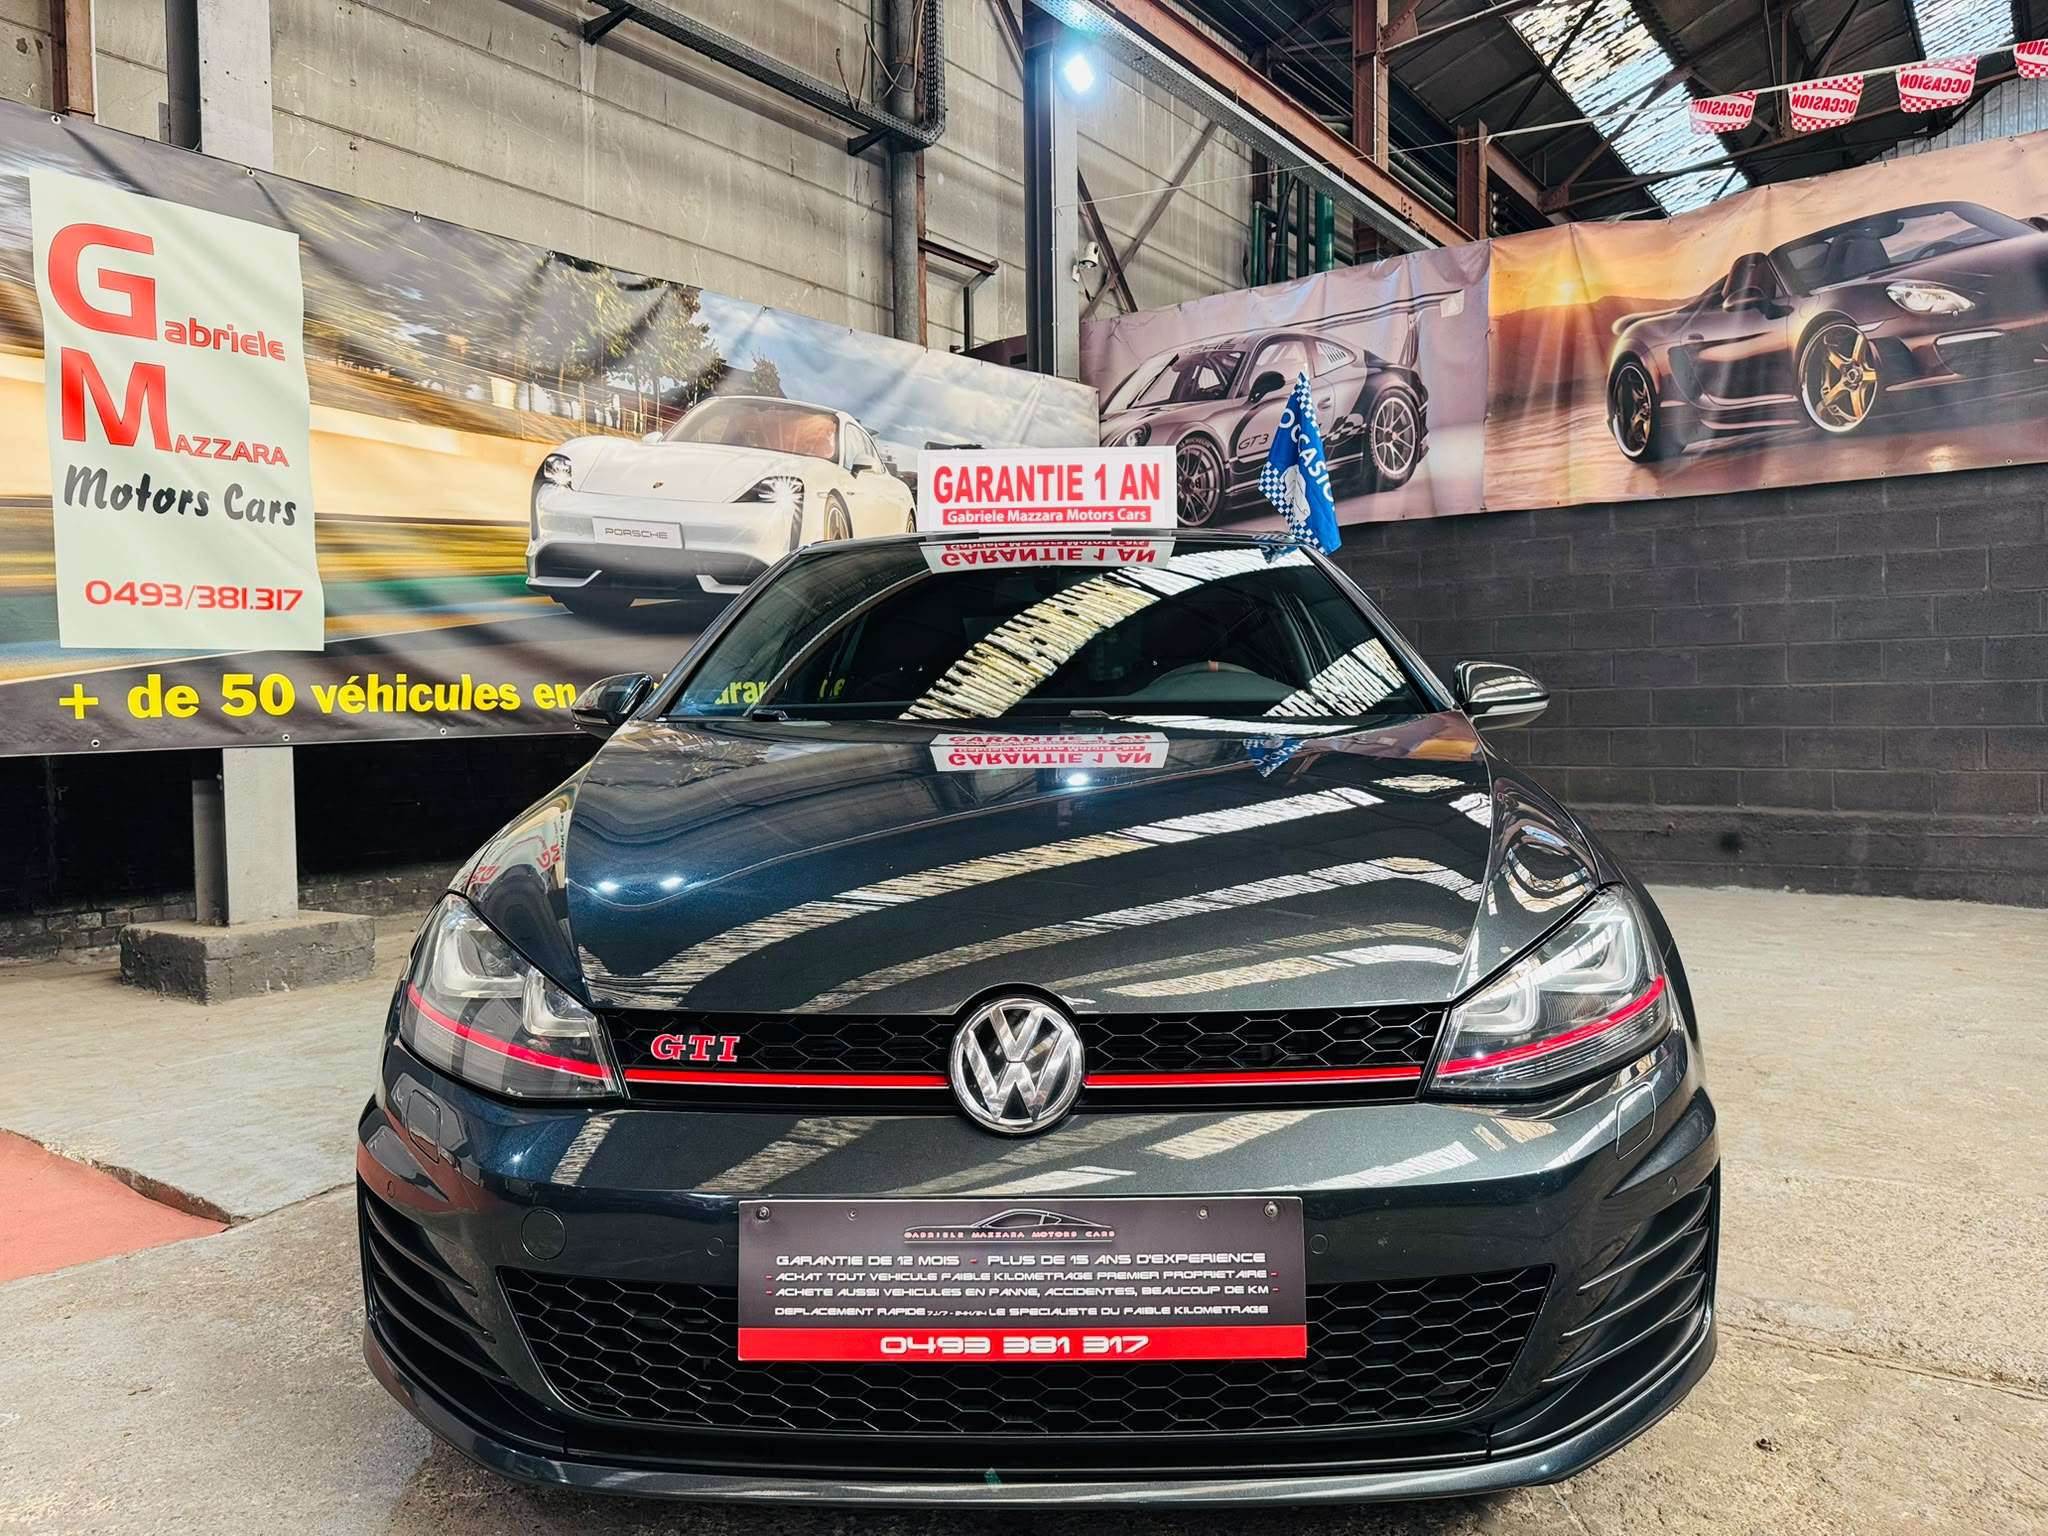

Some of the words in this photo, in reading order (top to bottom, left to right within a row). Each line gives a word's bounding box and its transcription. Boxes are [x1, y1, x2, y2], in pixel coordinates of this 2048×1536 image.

[1238, 433, 1270, 450] GT3
[933, 464, 1084, 504] GARANTIE
[1094, 464, 1106, 501] 1
[1120, 464, 1160, 500] AN
[65, 466, 208, 516] Motors
[225, 484, 296, 525] Cars
[948, 510, 1004, 522] Gabriele
[1008, 510, 1063, 521] Mazzara
[1067, 509, 1114, 520] Motors
[1118, 508, 1146, 520] Cars
[605, 528, 669, 539] PORSCHE
[85, 580, 304, 612] 0493/381.317
[128, 674, 199, 718] de
[222, 673, 295, 716] 50
[312, 674, 521, 714] véhicules
[534, 684, 576, 709] en
[651, 1030, 740, 1063] GTI
[775, 1255, 864, 1266] GARANTIE
[867, 1255, 893, 1266] DE
[896, 1255, 914, 1266] 12
[917, 1255, 960, 1266] MOIS
[986, 1254, 1036, 1266] PLUS
[1040, 1254, 1066, 1266] DE
[1069, 1254, 1090, 1265] 15
[1093, 1254, 1132, 1265] ANS
[1136, 1252, 1266, 1265] D'EXPERIENCE
[775, 1272, 824, 1282] ACHAT
[826, 1272, 867, 1282] TOUT
[868, 1272, 938, 1282] VEHICULE
[940, 1272, 991, 1282] FAIBLE
[993, 1271, 1094, 1281] KILOMETRAGE
[1096, 1270, 1160, 1281] PREMIER
[1162, 1269, 1268, 1280] PROPRIETAIRE
[775, 1287, 834, 1297] ACHETE
[836, 1287, 880, 1297] AUSSI
[882, 1287, 962, 1297] VEHICULES
[964, 1287, 986, 1297] EN
[988, 1287, 1041, 1298] PANNE,
[1043, 1286, 1138, 1297] ACCIDENTES,
[1141, 1285, 1221, 1296] BEAUCOUP
[1224, 1285, 1245, 1295] DE
[1247, 1285, 1269, 1295] KM
[774, 1307, 875, 1316] DEPLACEMENT
[876, 1307, 926, 1316] RAPIDE
[988, 1307, 1006, 1316] LE
[1008, 1307, 1098, 1316] SPECIALISTE
[1100, 1307, 1121, 1316] DU
[1123, 1306, 1171, 1316] FAIBLE
[1173, 1305, 1269, 1315] KILOMETRAGE
[880, 1336, 991, 1354] 0493
[1003, 1336, 1070, 1354] 381
[1083, 1335, 1149, 1353] 317
